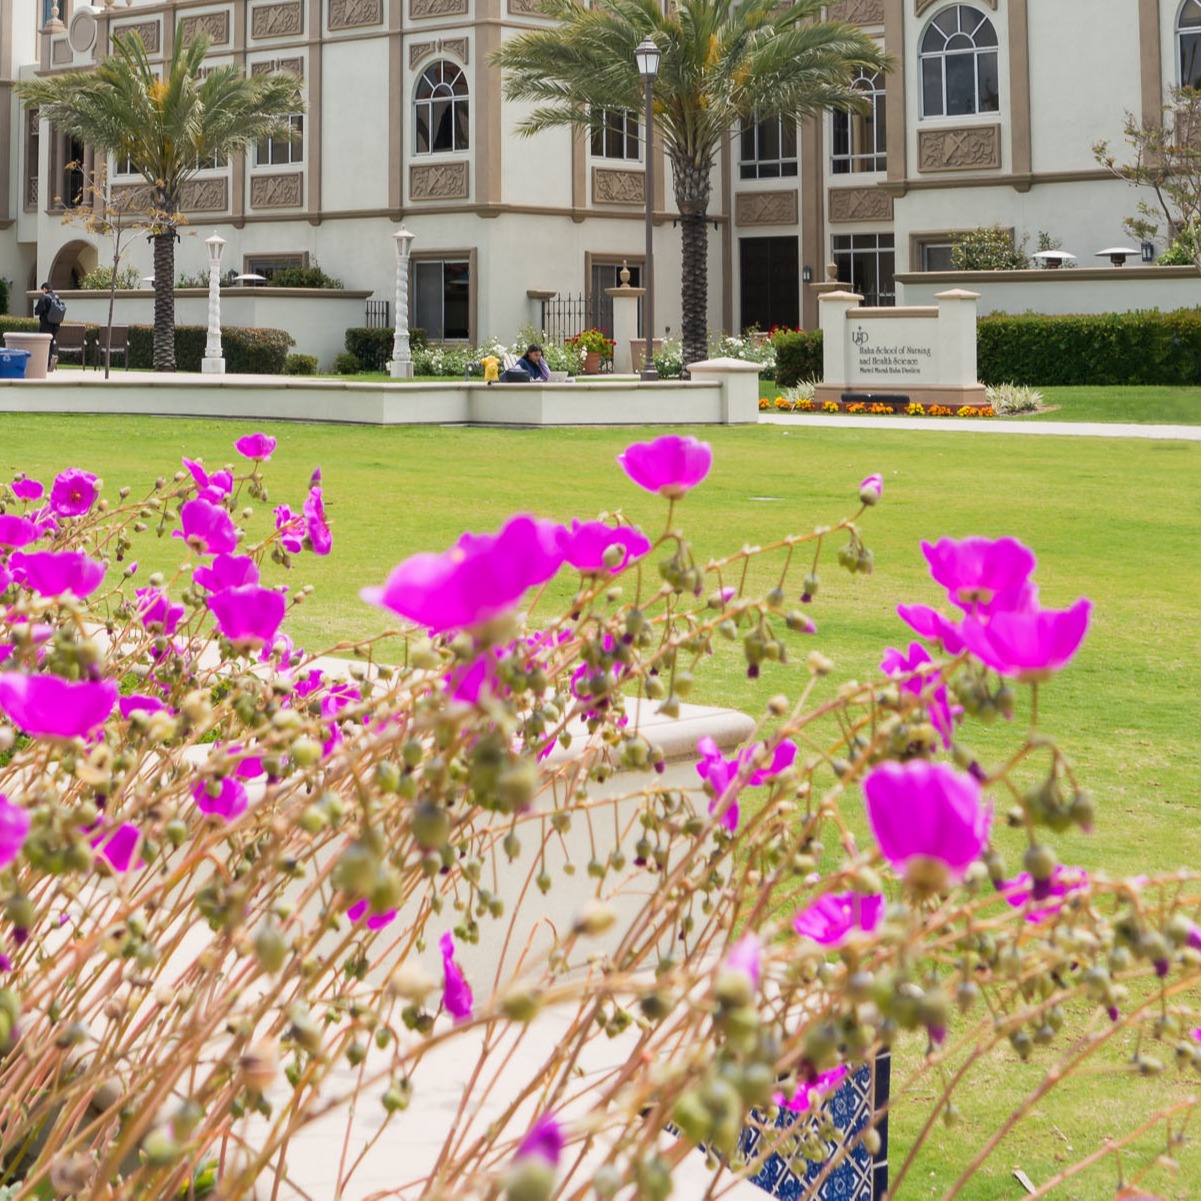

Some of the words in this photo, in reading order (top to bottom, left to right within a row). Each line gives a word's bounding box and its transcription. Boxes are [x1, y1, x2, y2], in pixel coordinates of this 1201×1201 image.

[876, 346, 898, 355] School
[898, 346, 906, 355] of
[906, 346, 932, 358] Nursing
[859, 357, 872, 365] and
[872, 357, 892, 365] Health
[893, 357, 919, 365] Science
